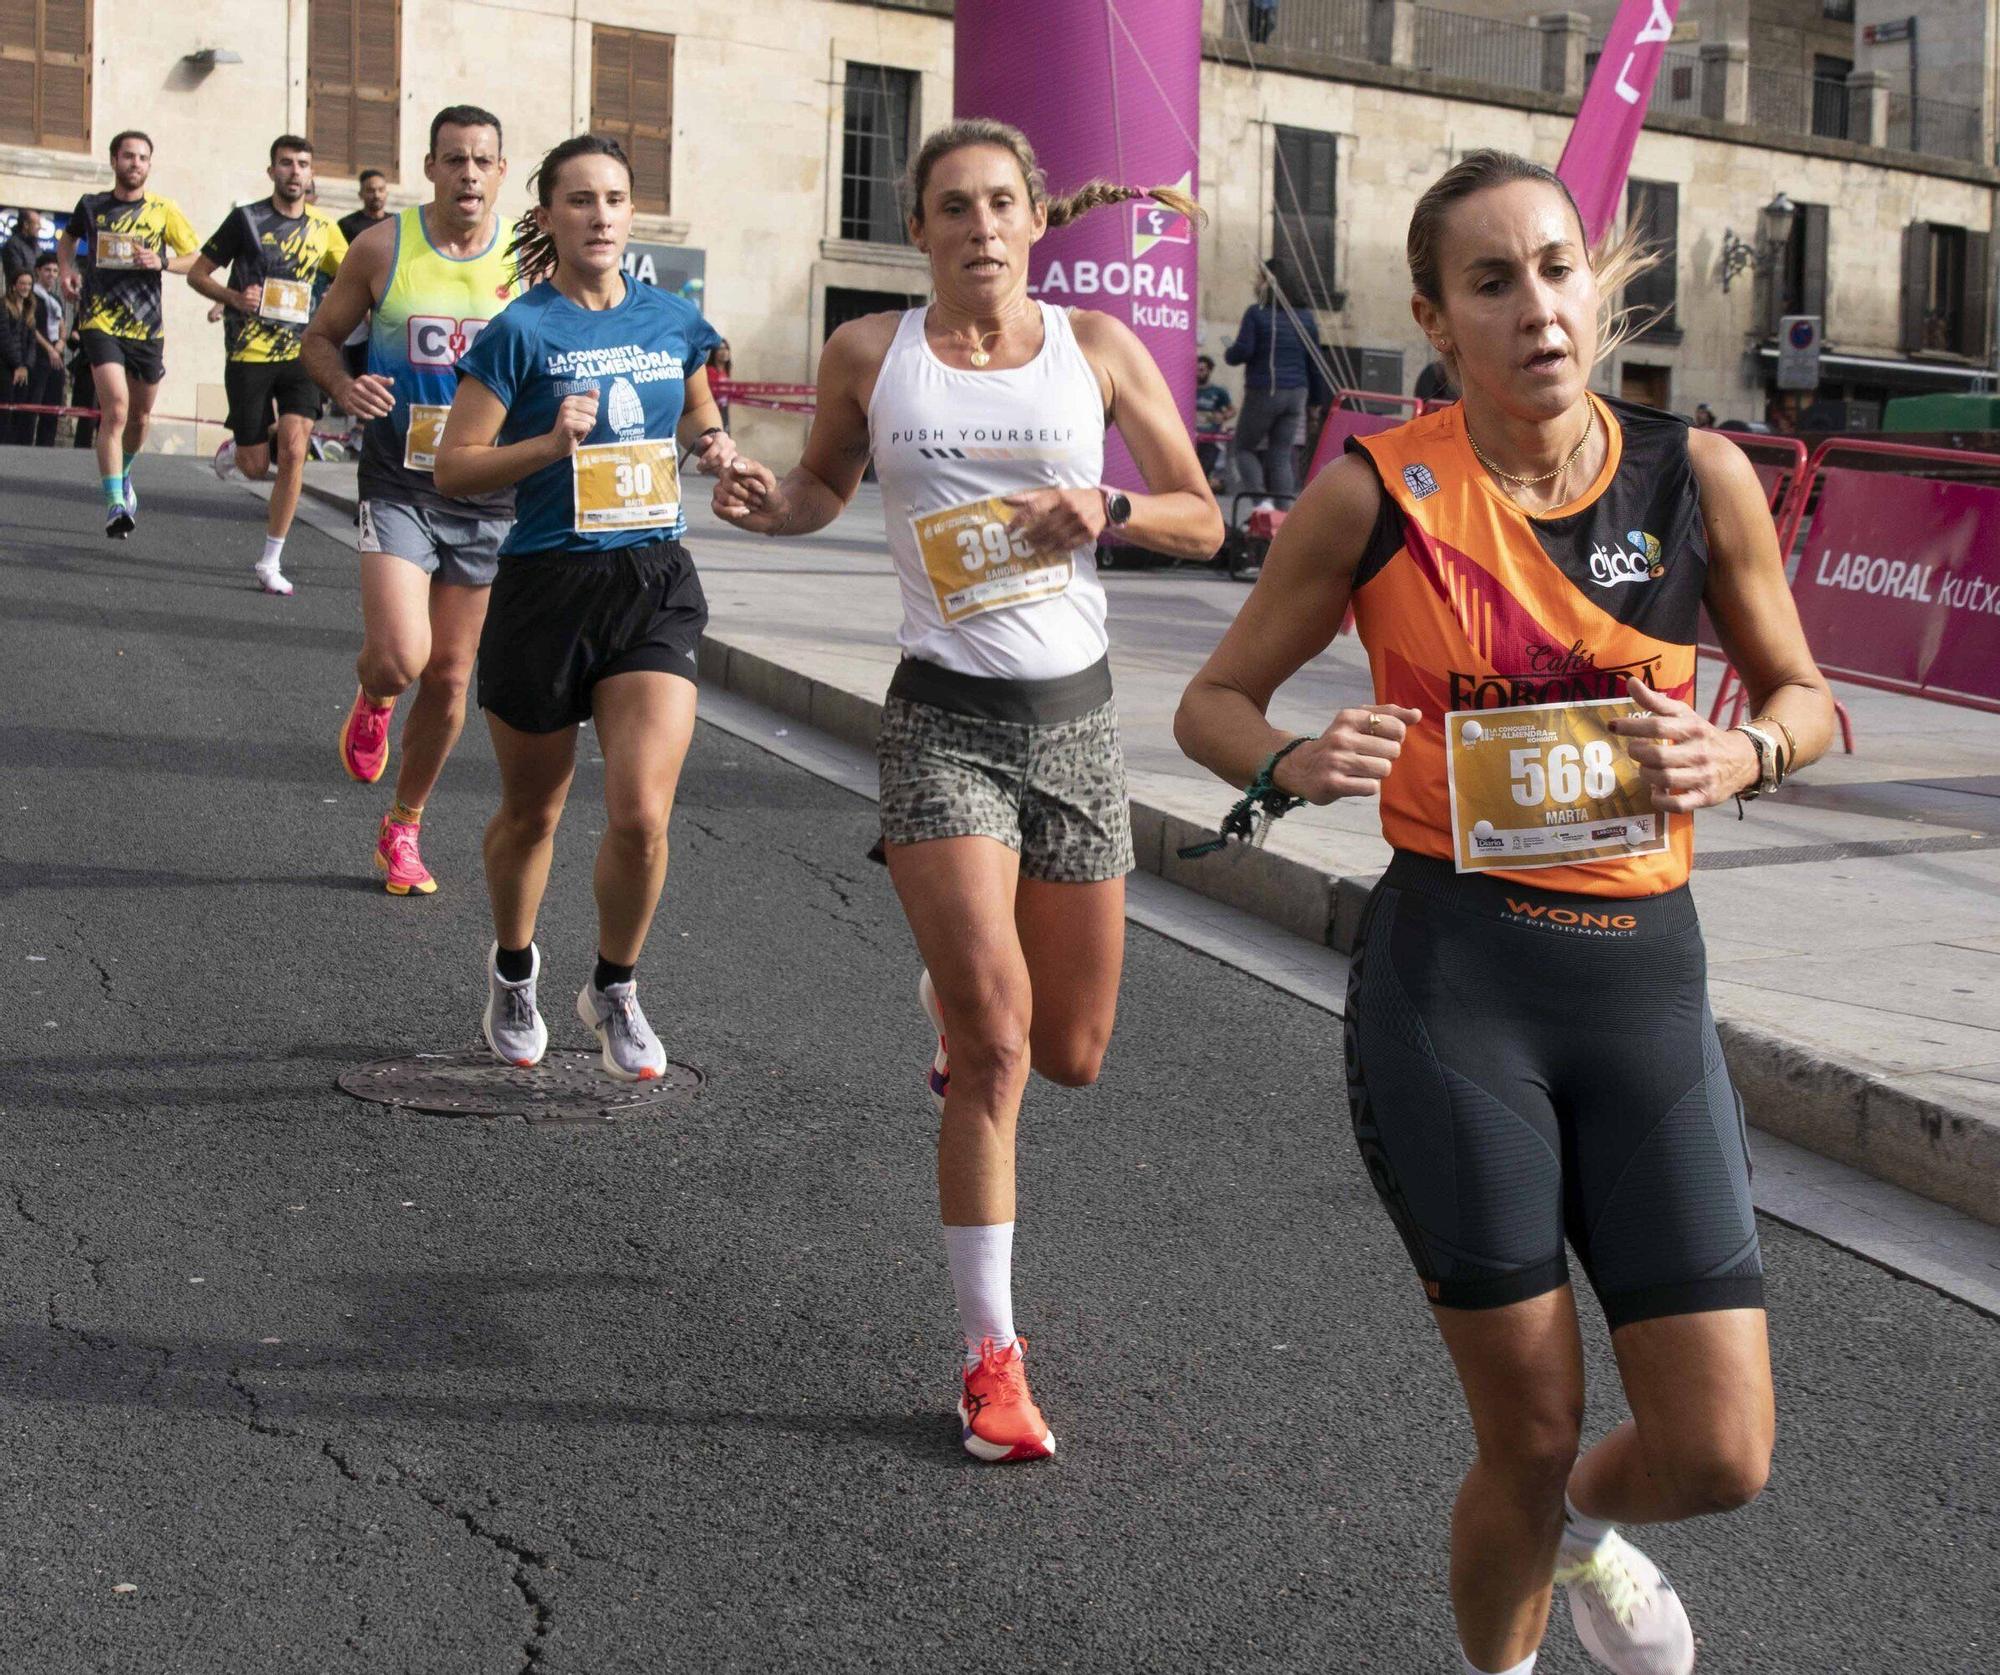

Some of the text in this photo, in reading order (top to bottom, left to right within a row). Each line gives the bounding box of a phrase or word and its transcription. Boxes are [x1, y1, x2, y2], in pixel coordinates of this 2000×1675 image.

[1027, 260, 1189, 301] ABORAL
[1132, 302, 1189, 330] kutxa
[548, 344, 645, 368] LA CONQUISTA
[551, 366, 563, 375] DE
[564, 364, 576, 373] LA
[575, 350, 672, 379] ALMENDRA
[892, 428, 1074, 444] PUSH YOURSELF
[615, 463, 652, 497] 30
[1816, 549, 1933, 603] LABORAL
[1526, 639, 1595, 675] Cafés
[1509, 740, 1617, 807] 568
[1545, 807, 1590, 825] MARTA
[1500, 911, 1638, 938] PERFORMANCE
[1504, 897, 1637, 930] WONG
